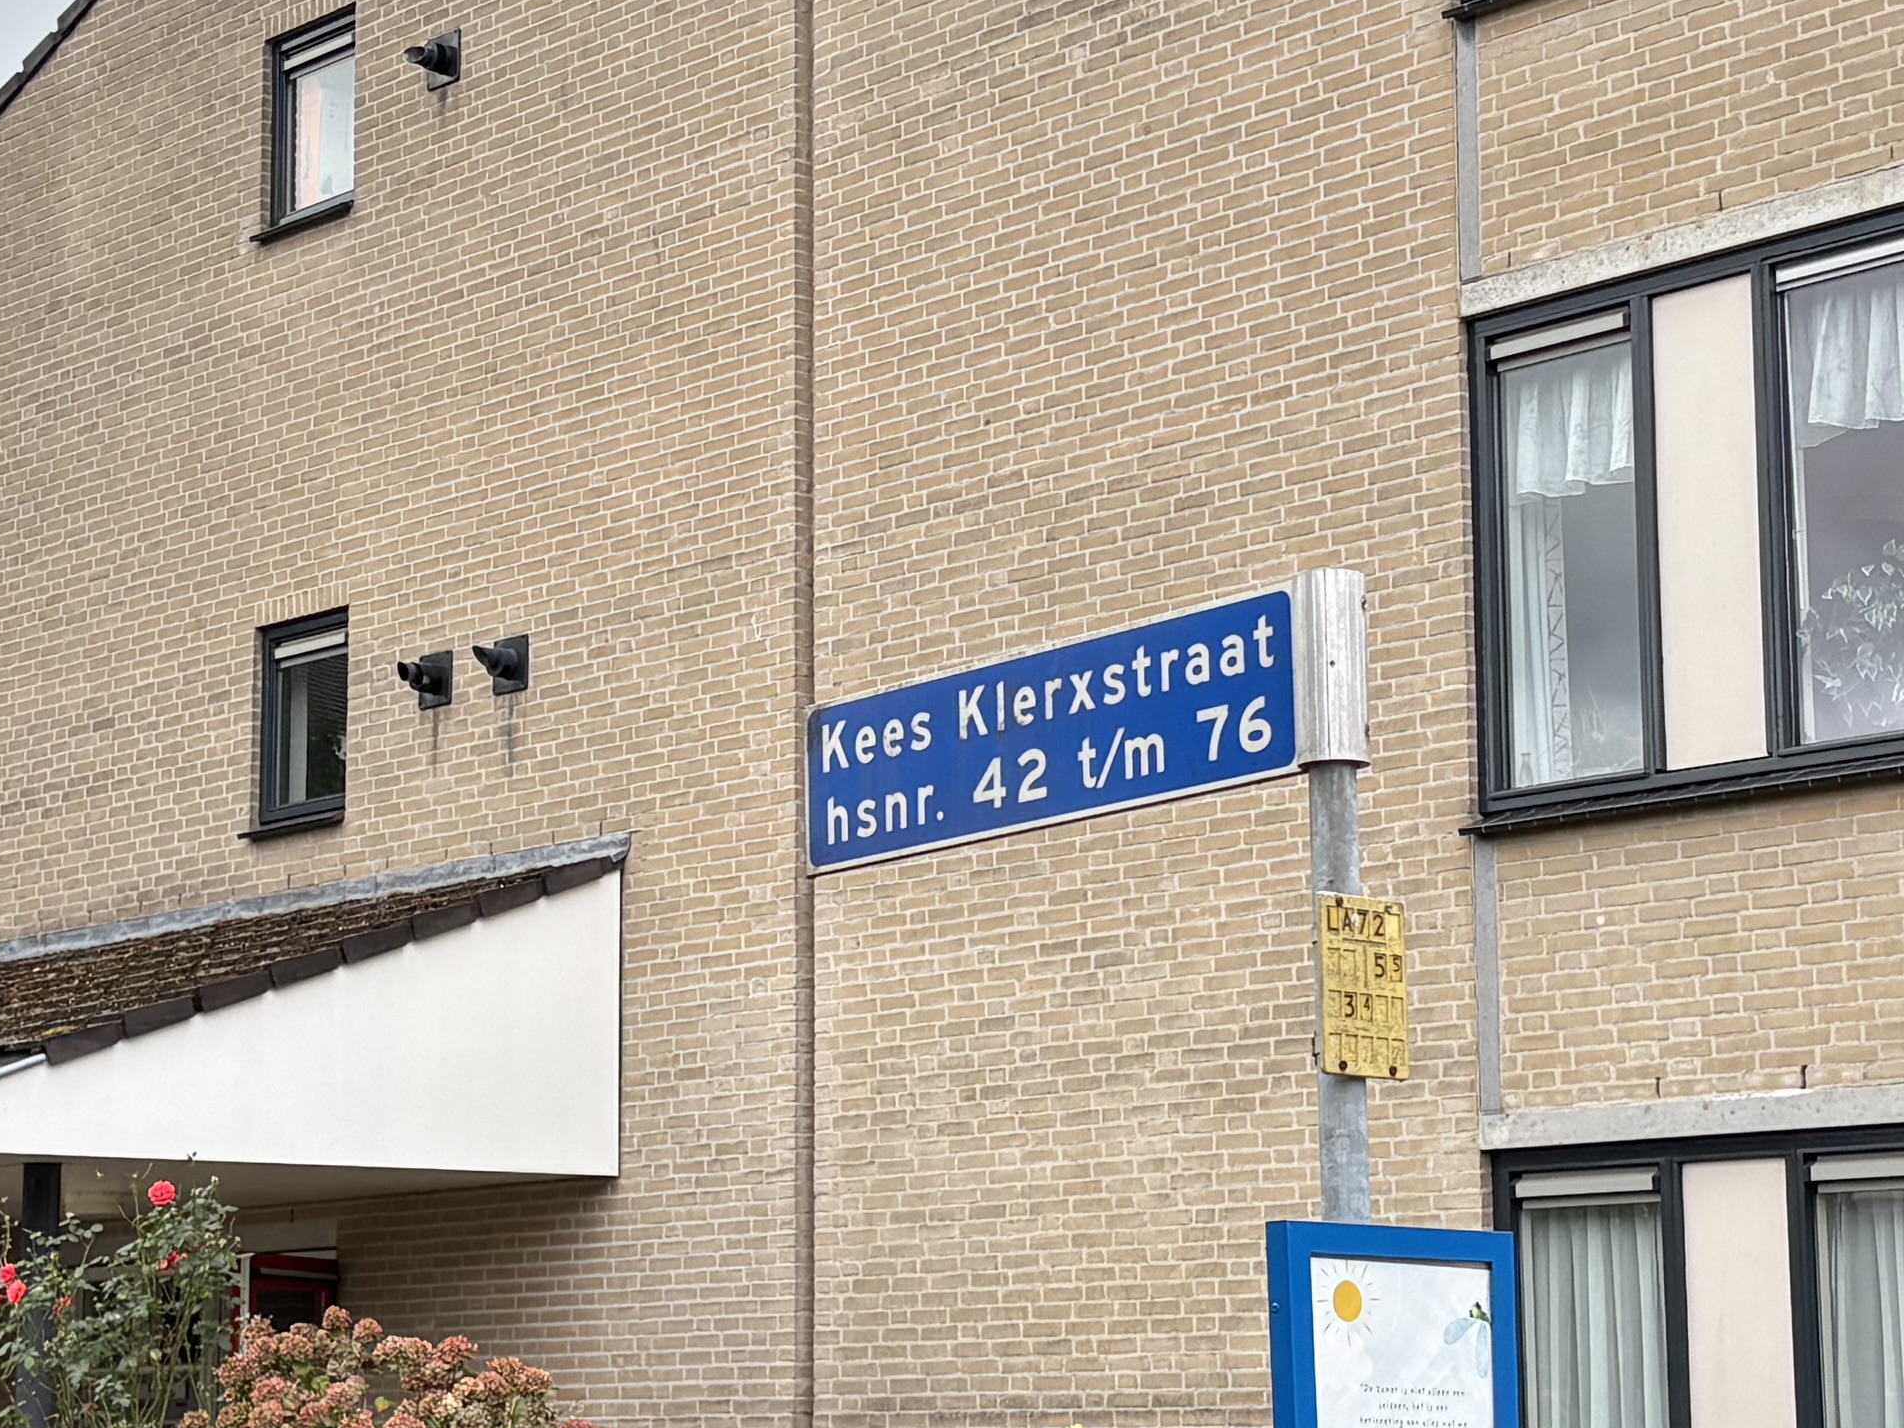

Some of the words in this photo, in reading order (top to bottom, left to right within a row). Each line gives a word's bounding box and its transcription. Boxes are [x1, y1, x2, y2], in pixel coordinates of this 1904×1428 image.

[821, 712, 933, 774] Kees
[958, 615, 1275, 741] Klerxstraat
[827, 784, 944, 846] hsnr.
[973, 748, 1049, 810] 42
[1078, 728, 1165, 789] t/m
[1197, 696, 1273, 762] 76
